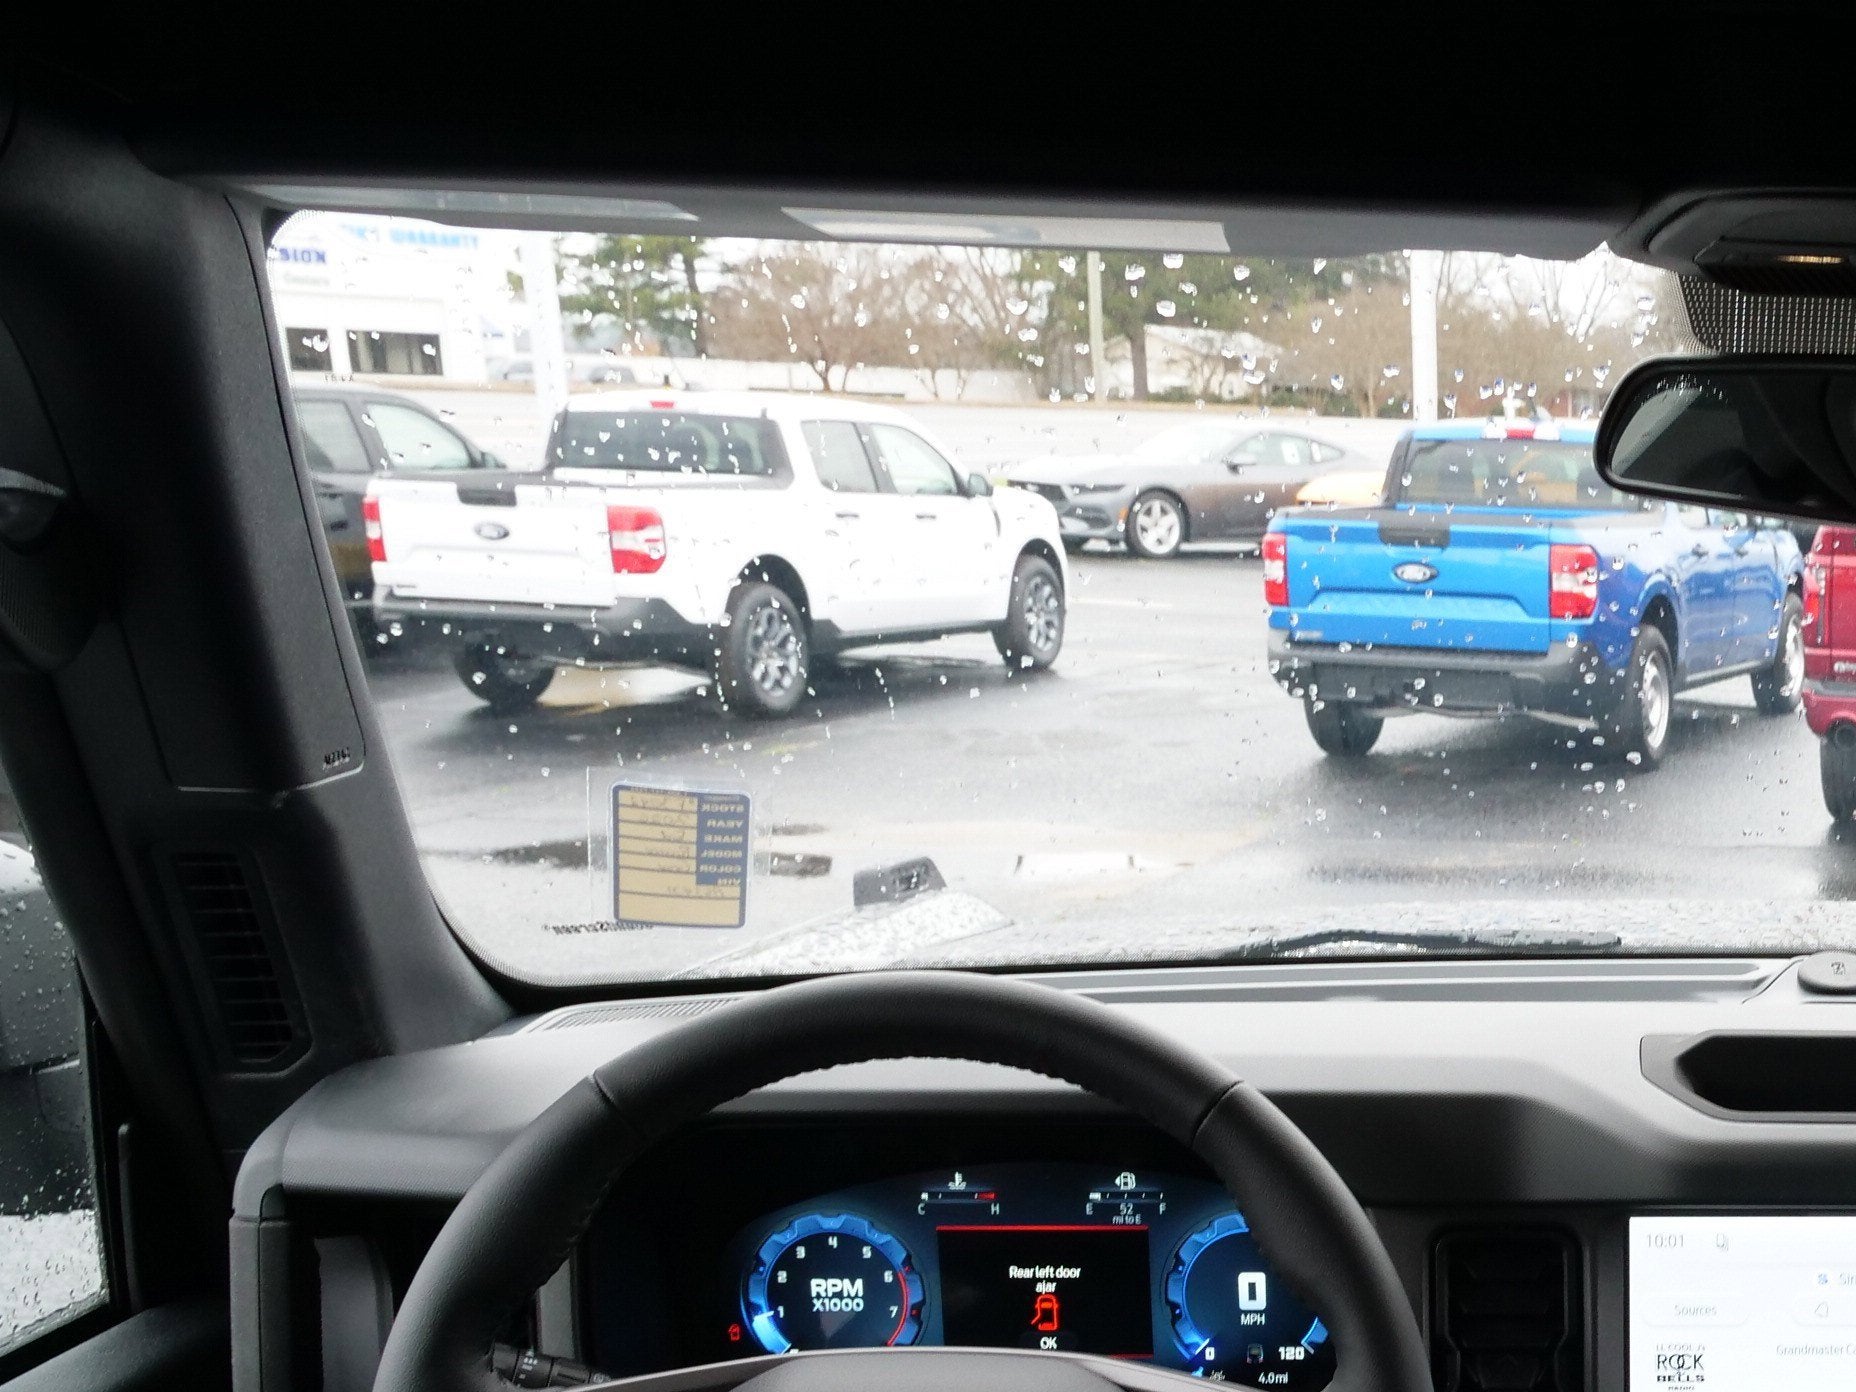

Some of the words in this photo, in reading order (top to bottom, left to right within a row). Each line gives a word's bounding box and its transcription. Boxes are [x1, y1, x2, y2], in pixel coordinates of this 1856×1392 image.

[918, 1203, 926, 1215] C
[991, 1203, 1000, 1215] H
[1086, 1203, 1094, 1215] E
[1120, 1203, 1134, 1215] 52
[1159, 1203, 1167, 1215] F
[828, 1236, 838, 1249] 4
[1646, 1233, 1685, 1248] 10:01
[796, 1246, 806, 1259] 3
[862, 1246, 872, 1259] 5
[777, 1270, 787, 1283] 2
[883, 1270, 893, 1283] 6
[1009, 1265, 1034, 1279] Rear
[1035, 1265, 1055, 1279] left
[1055, 1265, 1081, 1279] door
[810, 1278, 864, 1298] RPM
[1035, 1280, 1057, 1295] ajar
[1238, 1272, 1267, 1310] 0
[777, 1305, 785, 1318] 1
[812, 1298, 865, 1312] X1000
[890, 1305, 898, 1318] 7
[1674, 1303, 1718, 1317] Sources
[1240, 1313, 1266, 1325] MPH
[1040, 1336, 1057, 1350] OK
[1776, 1343, 1844, 1355] Grandmaster
[1204, 1346, 1215, 1360] 0
[1278, 1346, 1305, 1360] 120
[1657, 1353, 1705, 1371] ROCK
[1275, 1372, 1289, 1384] mi
